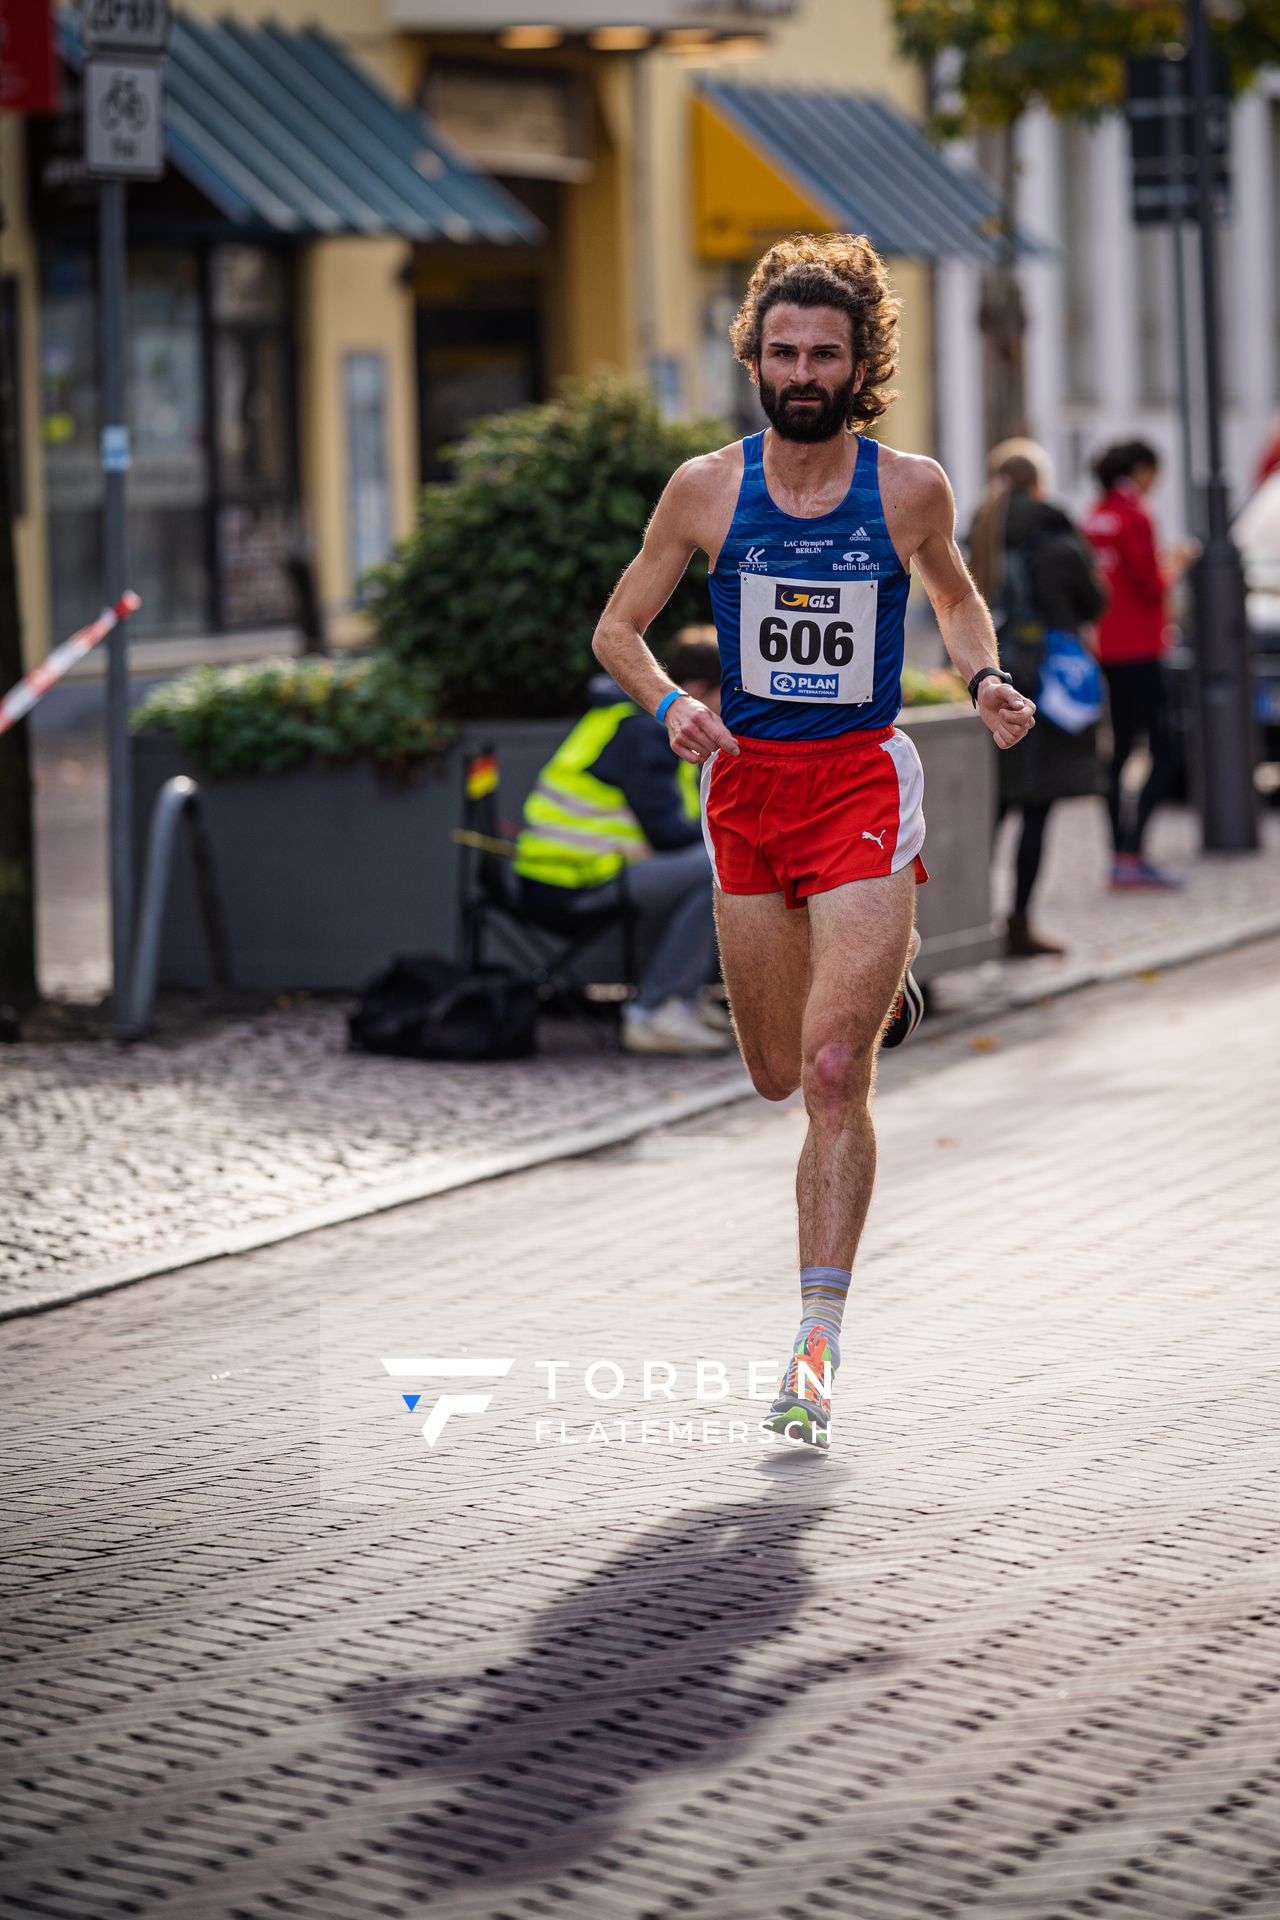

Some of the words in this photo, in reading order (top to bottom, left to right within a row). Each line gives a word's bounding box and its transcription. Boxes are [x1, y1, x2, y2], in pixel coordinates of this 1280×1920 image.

[832, 563, 857, 571] Berlin
[809, 595, 834, 608] GLS
[759, 616, 854, 667] 606
[798, 678, 836, 689] PLAN
